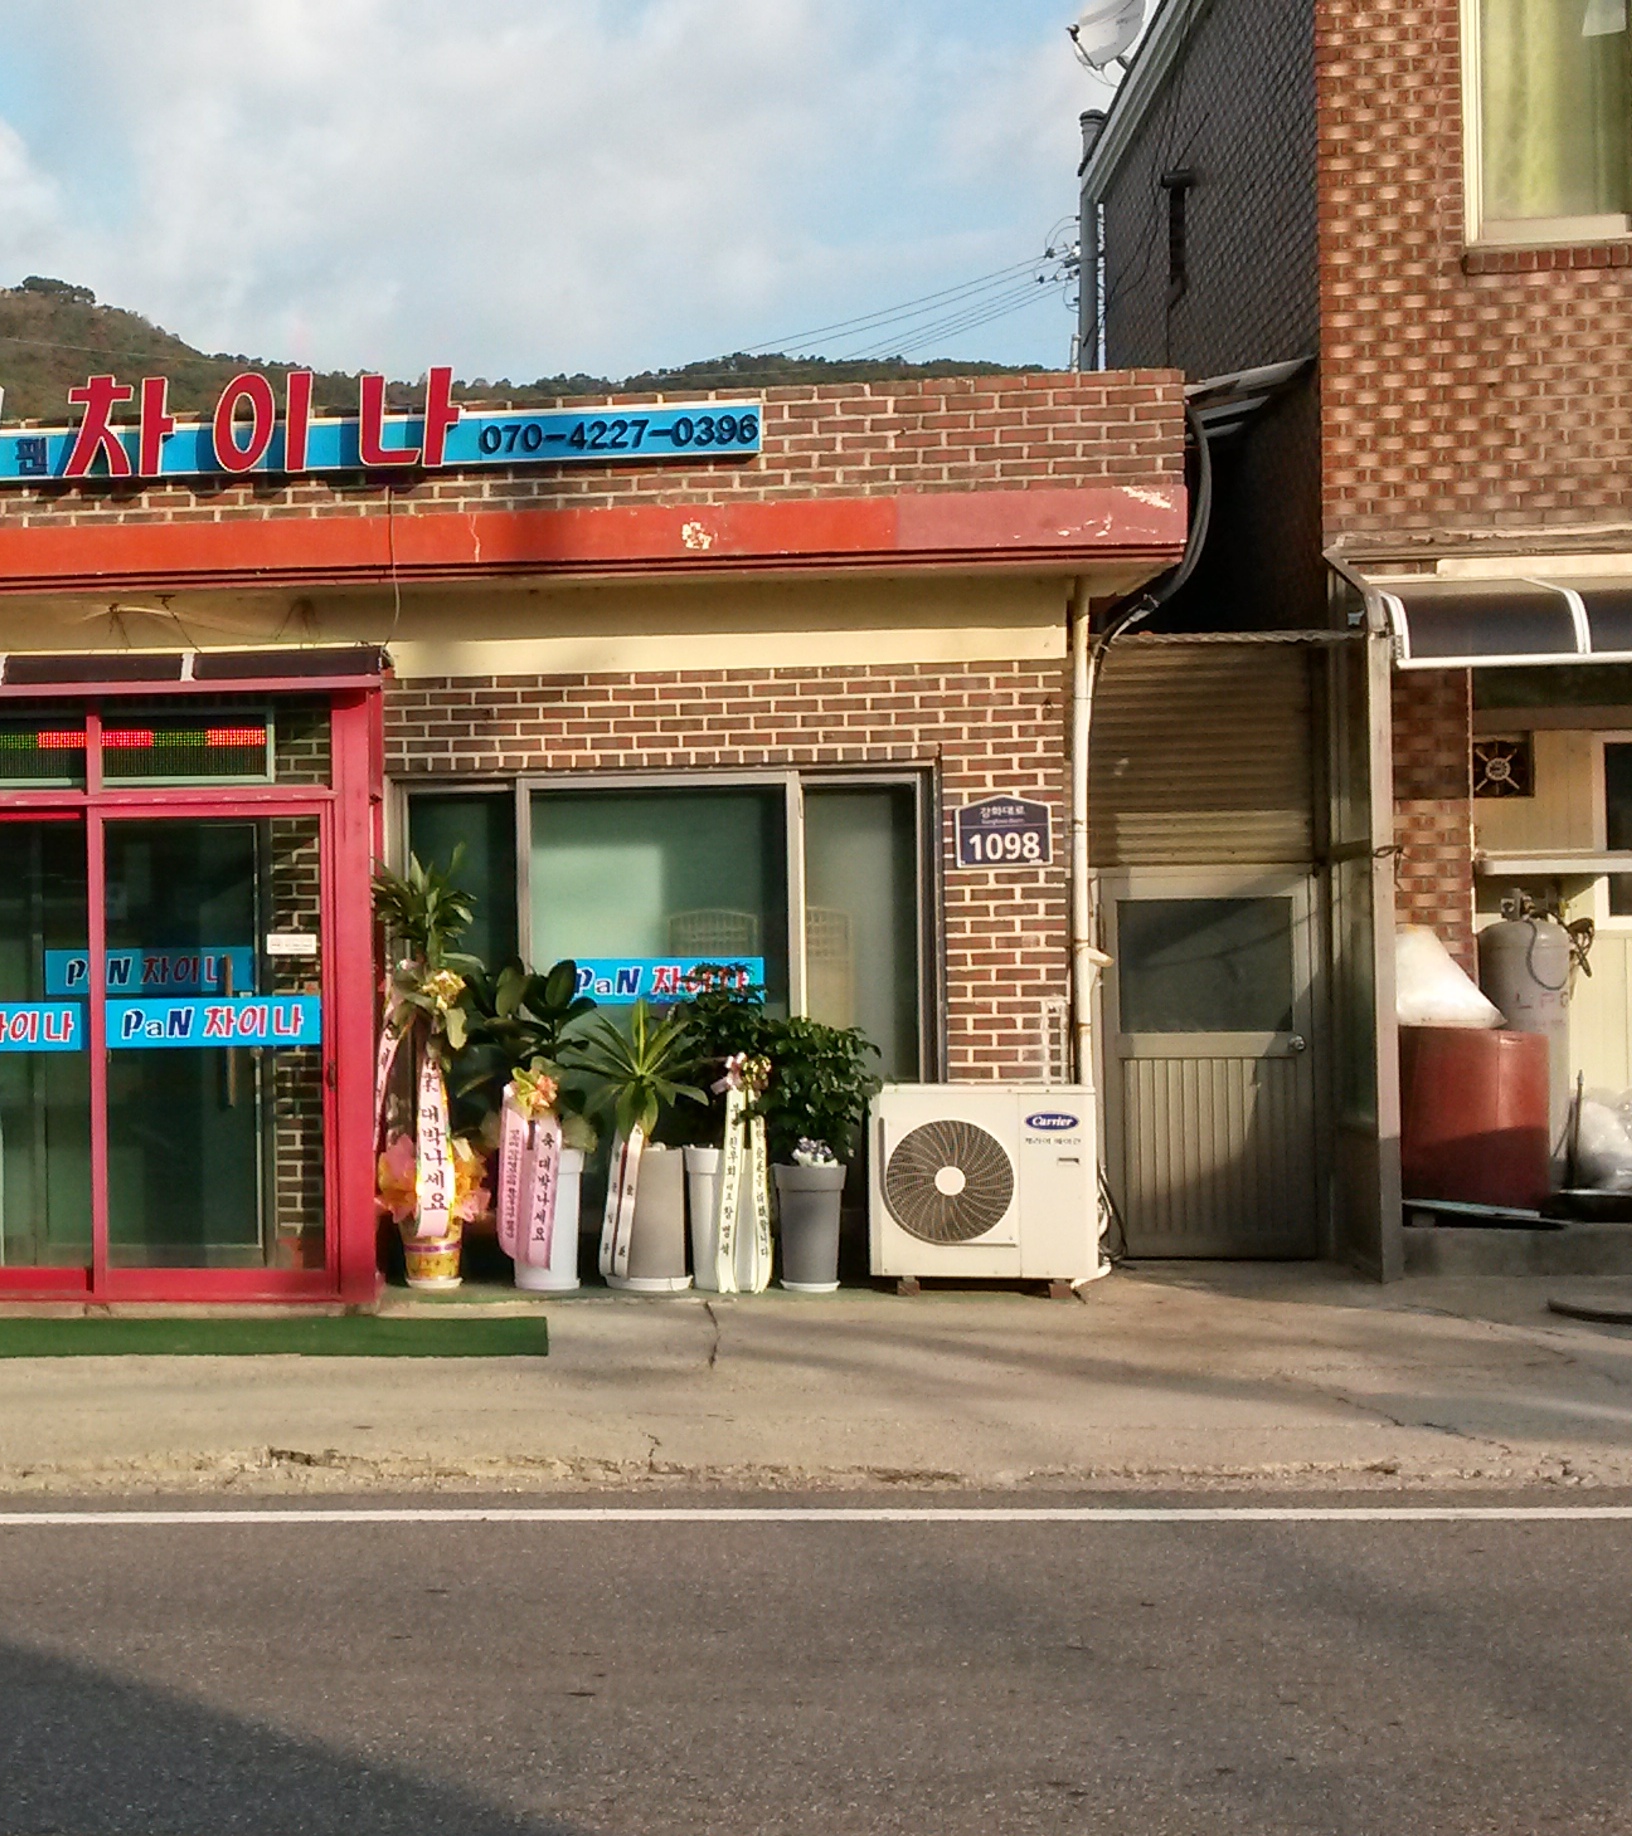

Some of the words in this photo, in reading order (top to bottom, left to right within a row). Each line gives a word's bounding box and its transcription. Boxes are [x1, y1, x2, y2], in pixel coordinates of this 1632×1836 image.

[64, 366, 463, 477] 차이나
[479, 412, 759, 456] 070-4227-0396
[979, 805, 1025, 819] 강화대로
[969, 832, 1041, 860] 1098
[66, 956, 133, 987] PN
[121, 1006, 195, 1039] PaN
[1031, 1116, 1074, 1127] Carrier
[421, 1105, 449, 1211] 대박나세요
[531, 1157, 552, 1242] 대박나세요
